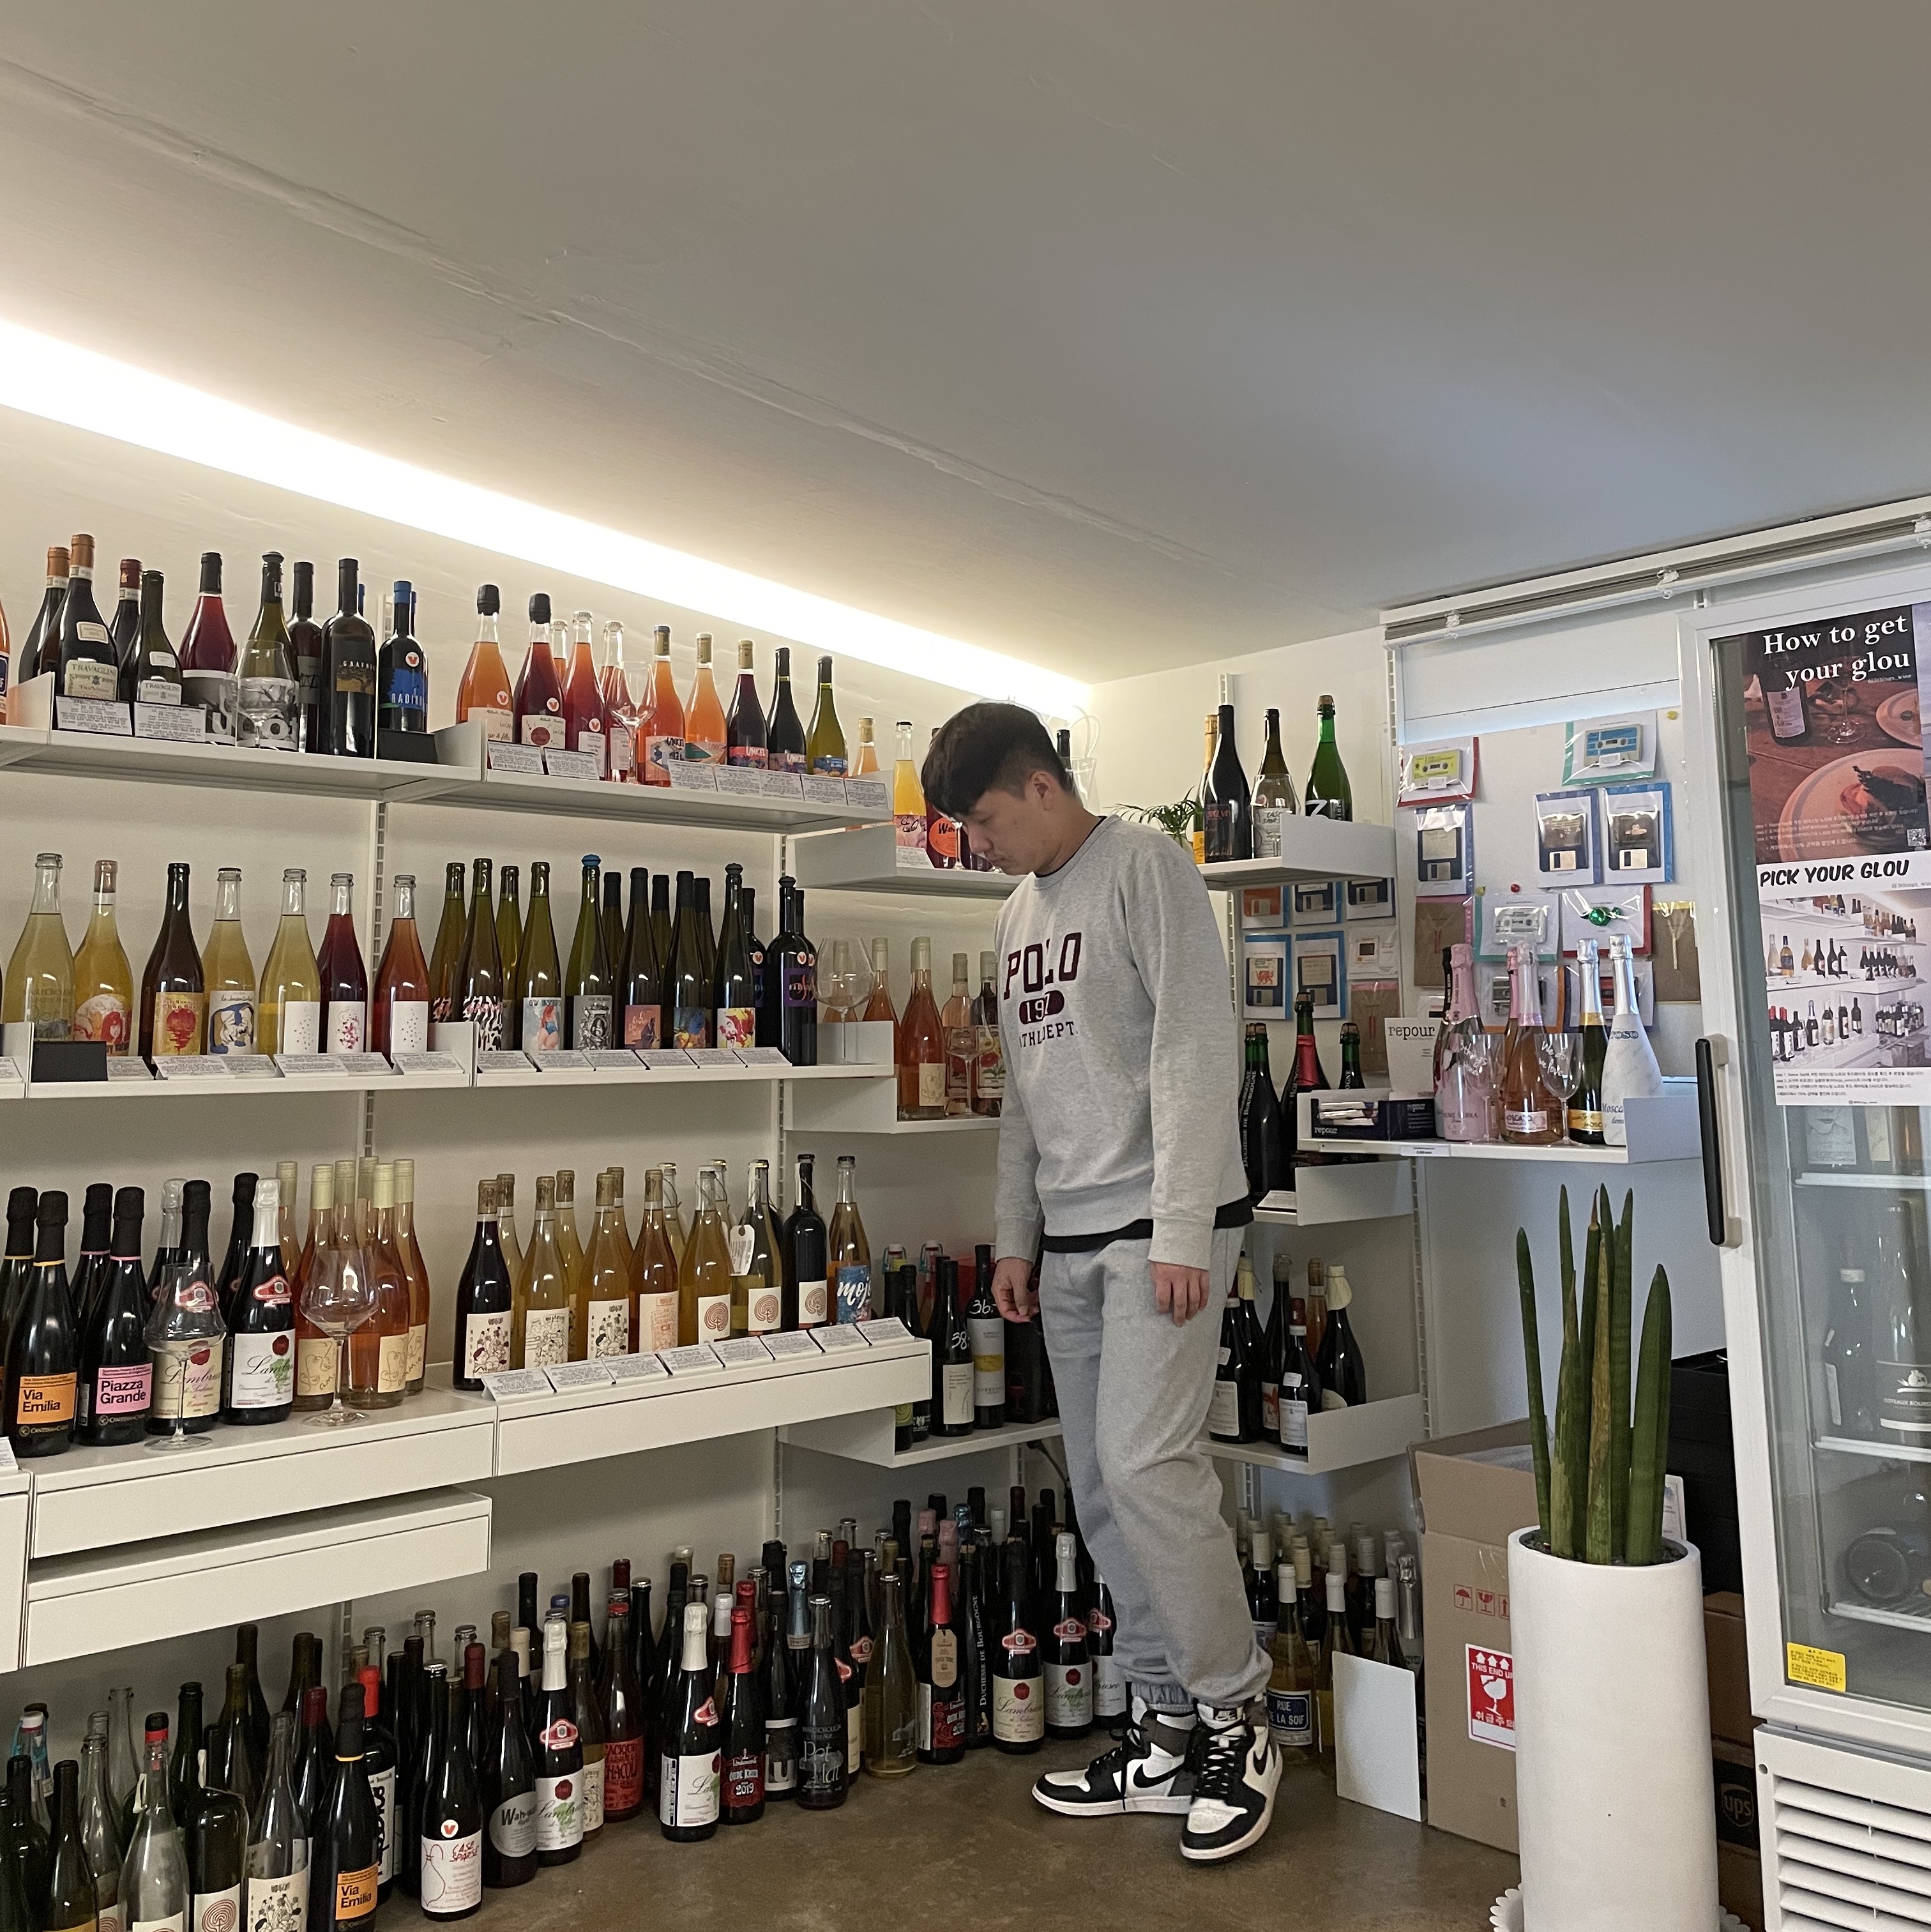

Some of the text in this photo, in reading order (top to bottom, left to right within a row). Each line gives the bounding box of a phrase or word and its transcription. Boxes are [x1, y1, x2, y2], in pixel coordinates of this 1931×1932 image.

[1763, 614, 1908, 655] How to get
[1785, 651, 1910, 691] your glou
[746, 747, 766, 757] UNKEL
[1760, 859, 1910, 887] PICK YOUR GLOU
[1388, 1025, 1435, 1040] repour
[1314, 1127, 1338, 1135] repour
[101, 1380, 143, 1392] Piazza
[23, 1389, 43, 1401] Via
[100, 1390, 146, 1404] Grande
[22, 1400, 61, 1413] Emilia
[973, 1595, 984, 1648] BOURGOGNE
[980, 1650, 986, 1660] DE
[1471, 1662, 1487, 1673] THIS
[1488, 1666, 1504, 1677] END
[1277, 1700, 1291, 1712] RUE
[1277, 1714, 1286, 1725] LA
[1289, 1714, 1305, 1725] SOIF
[736, 1782, 754, 1795] 2019
[1723, 1795, 1752, 1821] ups
[341, 1885, 359, 1896] Via
[341, 1892, 372, 1908] Emilia
